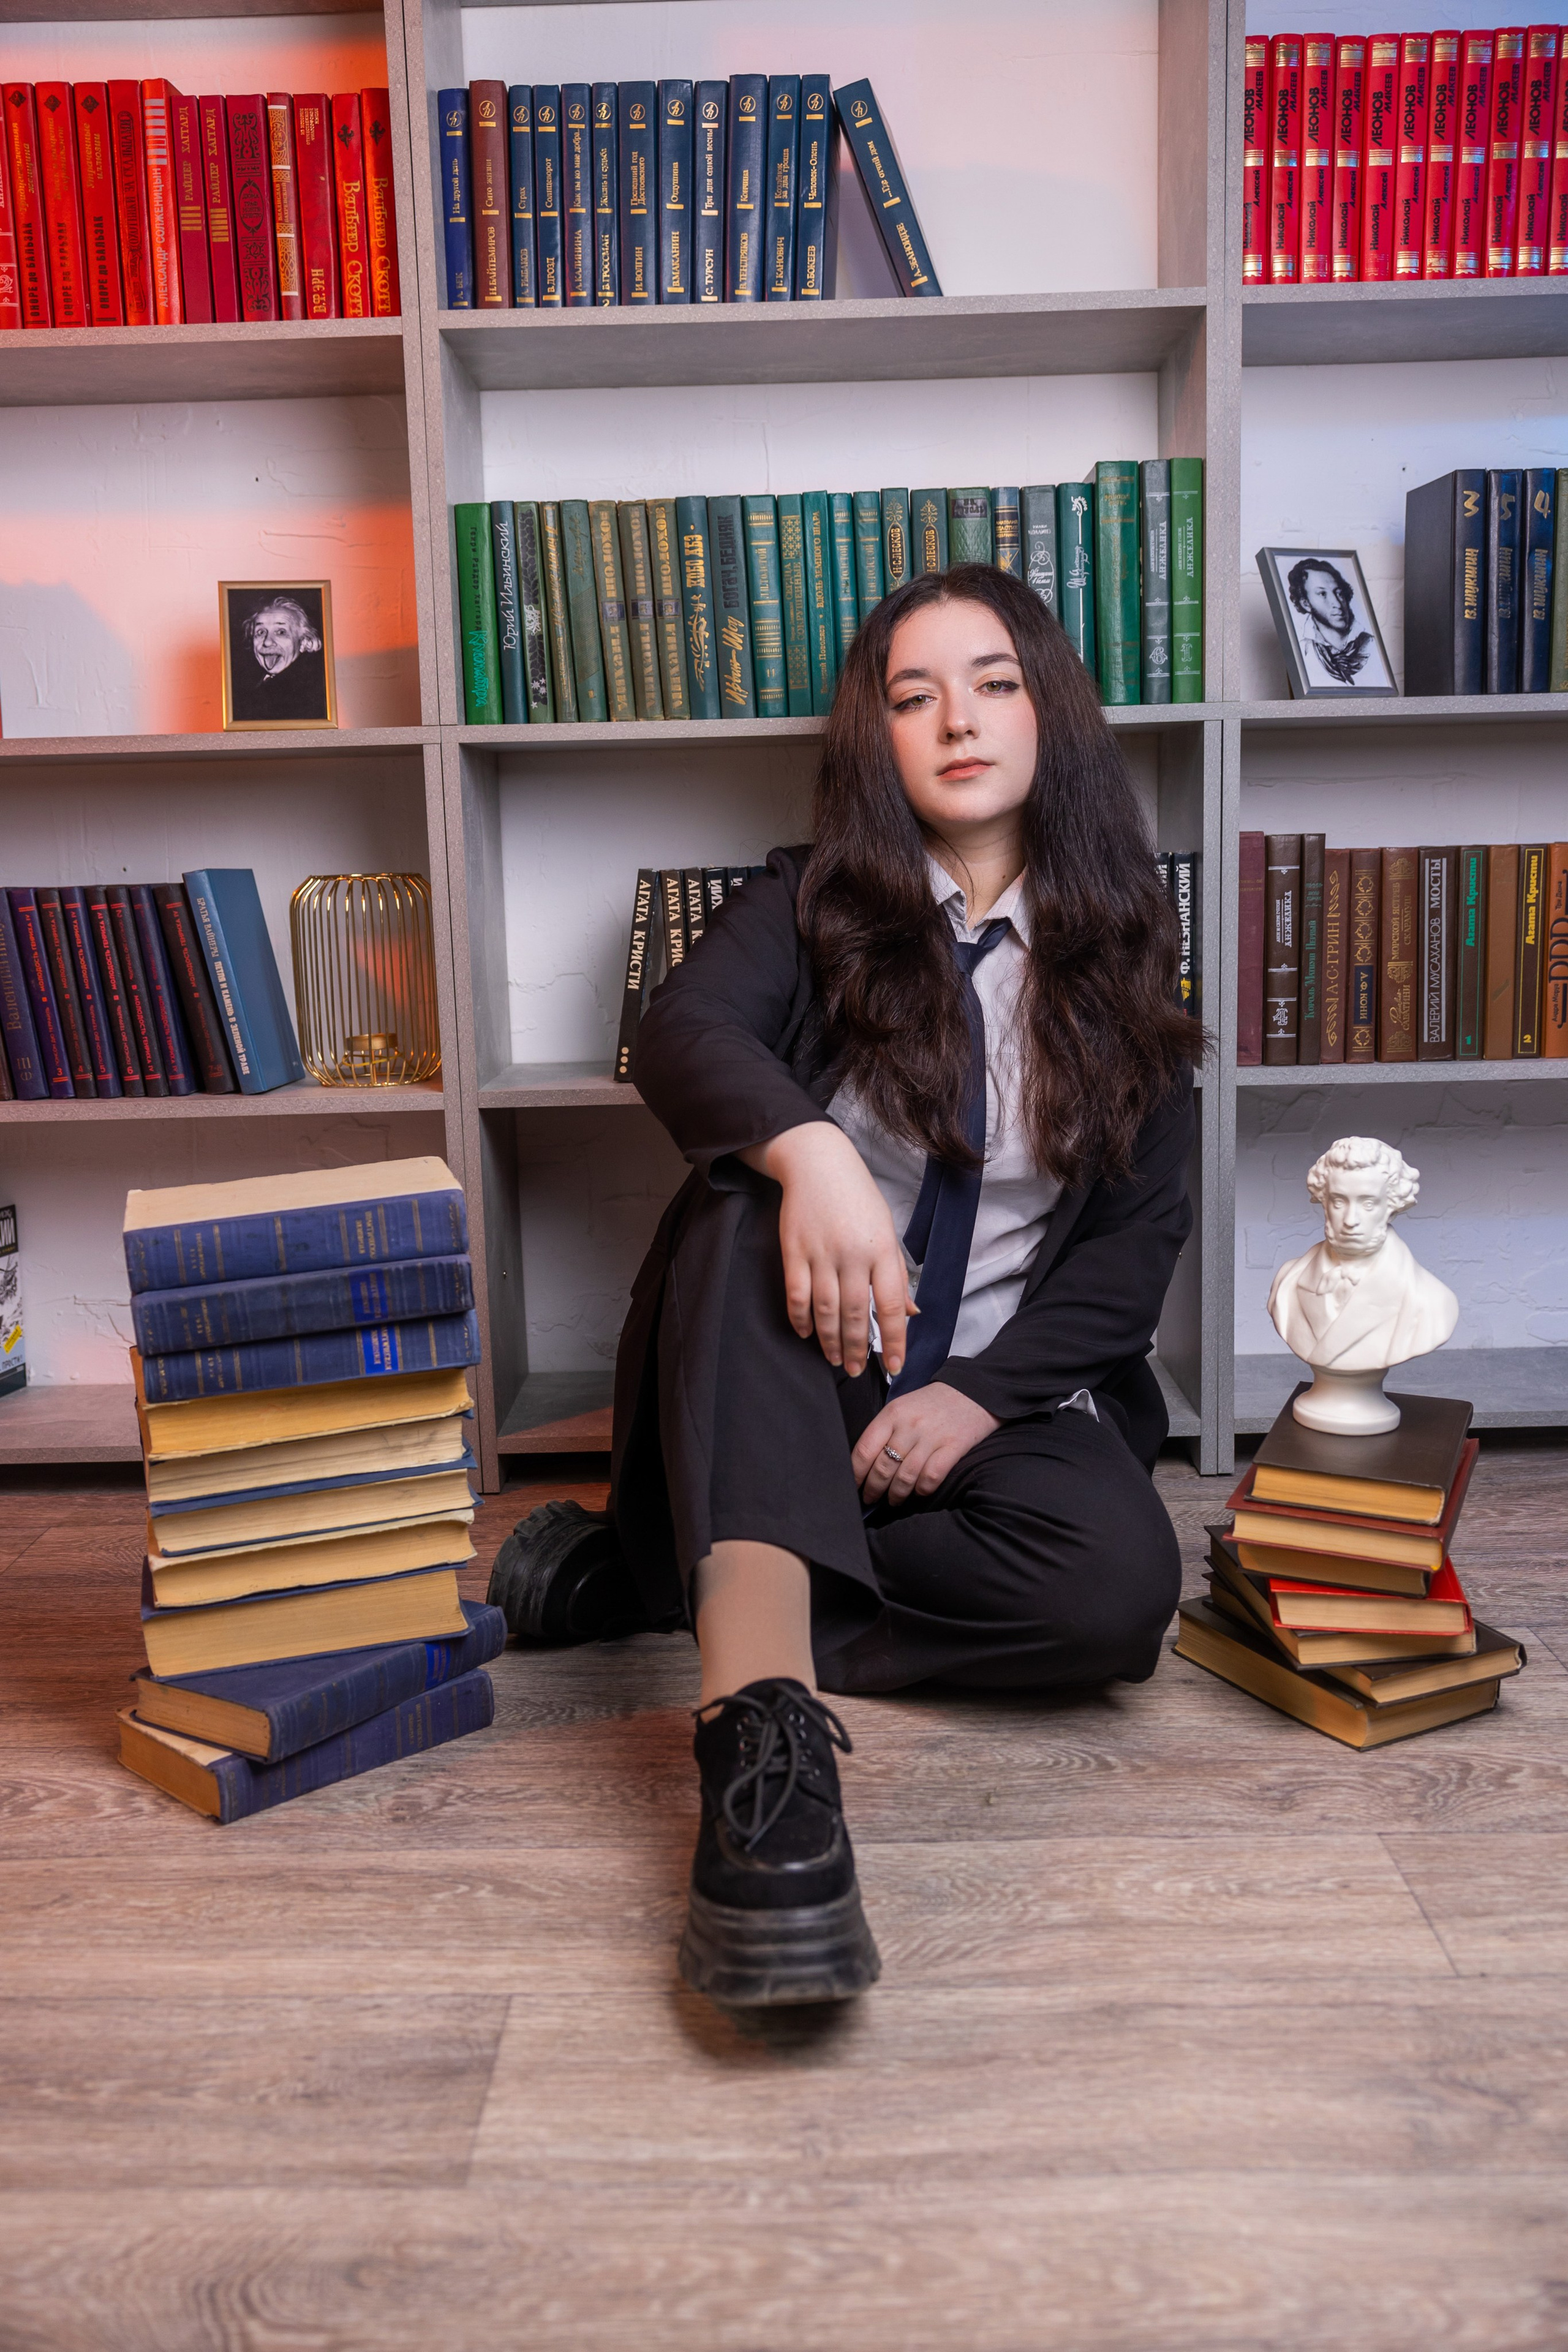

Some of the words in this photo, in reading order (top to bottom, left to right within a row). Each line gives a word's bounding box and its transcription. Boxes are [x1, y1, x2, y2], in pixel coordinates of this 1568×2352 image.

[1255, 70, 1264, 111] МАКЕЕВ
[1289, 71, 1298, 113] МАКЕЕВ
[1320, 69, 1329, 111] МАКЕЕВ
[1352, 71, 1362, 113] МАКЕЕВ
[1384, 72, 1393, 115] МАКЕЕВ
[178, 106, 191, 154] ХАГГАРД
[205, 108, 218, 156] ХАГГАРД
[1243, 88, 1255, 145] ЛЕОНОВ
[1277, 88, 1289, 146] ЛЕОНОВ
[1308, 86, 1320, 144] ЛЕОНОВ
[1340, 88, 1353, 146] ЛЕОНОВ
[1371, 91, 1384, 148] ЛЕОНОВ
[1403, 84, 1416, 141] ЛЕОНОВ
[1434, 83, 1447, 141] ЛЕОНОВ
[866, 140, 880, 156] дом
[1411, 166, 1420, 205] Алексей
[1416, 66, 1425, 109] МАКЕЕВ
[1441, 165, 1450, 205] Алексей
[1447, 66, 1457, 108] МАКЕЕВ
[484, 159, 493, 185] жизни
[599, 147, 609, 172] судьба
[704, 153, 714, 176] одной
[808, 141, 818, 201] Человек-Олень
[183, 160, 194, 202] РАЙДЕР
[209, 162, 221, 204] РАЙДЕР
[485, 186, 494, 208] Сито
[517, 186, 527, 209] Страх
[545, 157, 554, 208] Солнцеворот
[573, 195, 582, 208] Как
[599, 179, 609, 207] Жизнь
[638, 157, 646, 206] Достоевского
[670, 161, 680, 203] Отдушина
[1253, 169, 1261, 208] Алексей
[1286, 170, 1294, 209] Алексей
[1316, 168, 1325, 208] Алексей
[1348, 170, 1357, 209] Алексей
[1380, 172, 1389, 211] Алексей
[152, 168, 166, 244] СОЛЖЕНИЦЫН
[704, 195, 715, 210] Три
[1400, 198, 1411, 246] Николай
[1430, 197, 1441, 245] Николай
[22, 222, 36, 268] БАЛЬЗАК
[93, 216, 107, 261] БАЛЬЗАК
[1275, 203, 1286, 250] Николай
[1306, 201, 1317, 248] Николай
[1338, 202, 1349, 249] Николай
[1370, 203, 1381, 251] Николай
[156, 247, 169, 308] АЛЕКСАНДР
[704, 248, 714, 285] ТУРСУН
[775, 236, 785, 279] КАНОВИЧ
[716, 514, 737, 566] БЕДНЯК
[812, 510, 821, 537] ШАРА
[496, 521, 514, 606] Ильинский
[683, 534, 705, 558] АБЭ
[813, 538, 823, 579] ЗЕМНОГО
[1158, 520, 1167, 581] АНЖЕЛИКА
[1185, 516, 1194, 578] АНЖЕЛИКА
[684, 559, 706, 588] КОБО
[815, 580, 824, 609] ВДОЛЬ
[500, 608, 519, 651] Юрий
[666, 876, 682, 922] АГАТА
[1392, 882, 1401, 915] ЯСТРЕБ
[1429, 858, 1442, 909] МОСТЫ
[1465, 857, 1479, 905] Кристи
[1526, 854, 1539, 903] Кристи
[196, 897, 210, 923] БРАТЬЯ
[635, 878, 652, 924] АГАТА
[687, 878, 703, 924] АГАТА
[1284, 890, 1292, 948] АНЖЕЛИКА
[1403, 894, 1412, 946] СКАРАМУШ
[28, 922, 37, 951] ГЕНРИХА
[50, 919, 60, 948] ГЕНРИХА
[72, 919, 83, 948] ГЕНРИХА
[99, 920, 110, 948] ГЕНРИХА
[176, 919, 187, 947] ГЕНРИХА
[203, 924, 220, 957] ВАЙНЕРЫ
[1390, 917, 1401, 960] МОРСКОЙ
[1464, 908, 1476, 947] Агата
[1525, 906, 1537, 944] Агата
[183, 948, 197, 988] МОЛОДОСТЬ
[627, 929, 646, 990] КРИСТИ
[669, 927, 684, 967] КРИС
[1428, 918, 1441, 989] МУСАХАНОВ
[33, 951, 45, 992] МОЛОДОСТЬ
[56, 948, 69, 989] МОЛОДОСТЬ
[78, 948, 90, 989] МОЛОДОСТЬ
[105, 949, 117, 990] МОЛОДОСТЬ
[213, 960, 227, 983] ПЕТЛЯ
[221, 989, 235, 1017] КАМЕНЬ
[1359, 993, 1368, 1020] КОНИ
[1402, 984, 1411, 1031] САБАТИНИ
[1428, 992, 1441, 1043] ВАЛЕРИЙ
[134, 995, 146, 1035] МОЛОДОСТЬ
[142, 1036, 152, 1064] ГЕНРИХА
[158, 995, 170, 1035] МОЛОДОСТЬ
[165, 1036, 176, 1064] ГЕНРИХА
[230, 1023, 247, 1054] ЗЕЛЕНОЙ
[1523, 1033, 1532, 1043] 2
[237, 1054, 251, 1076] ТРАВЕ
